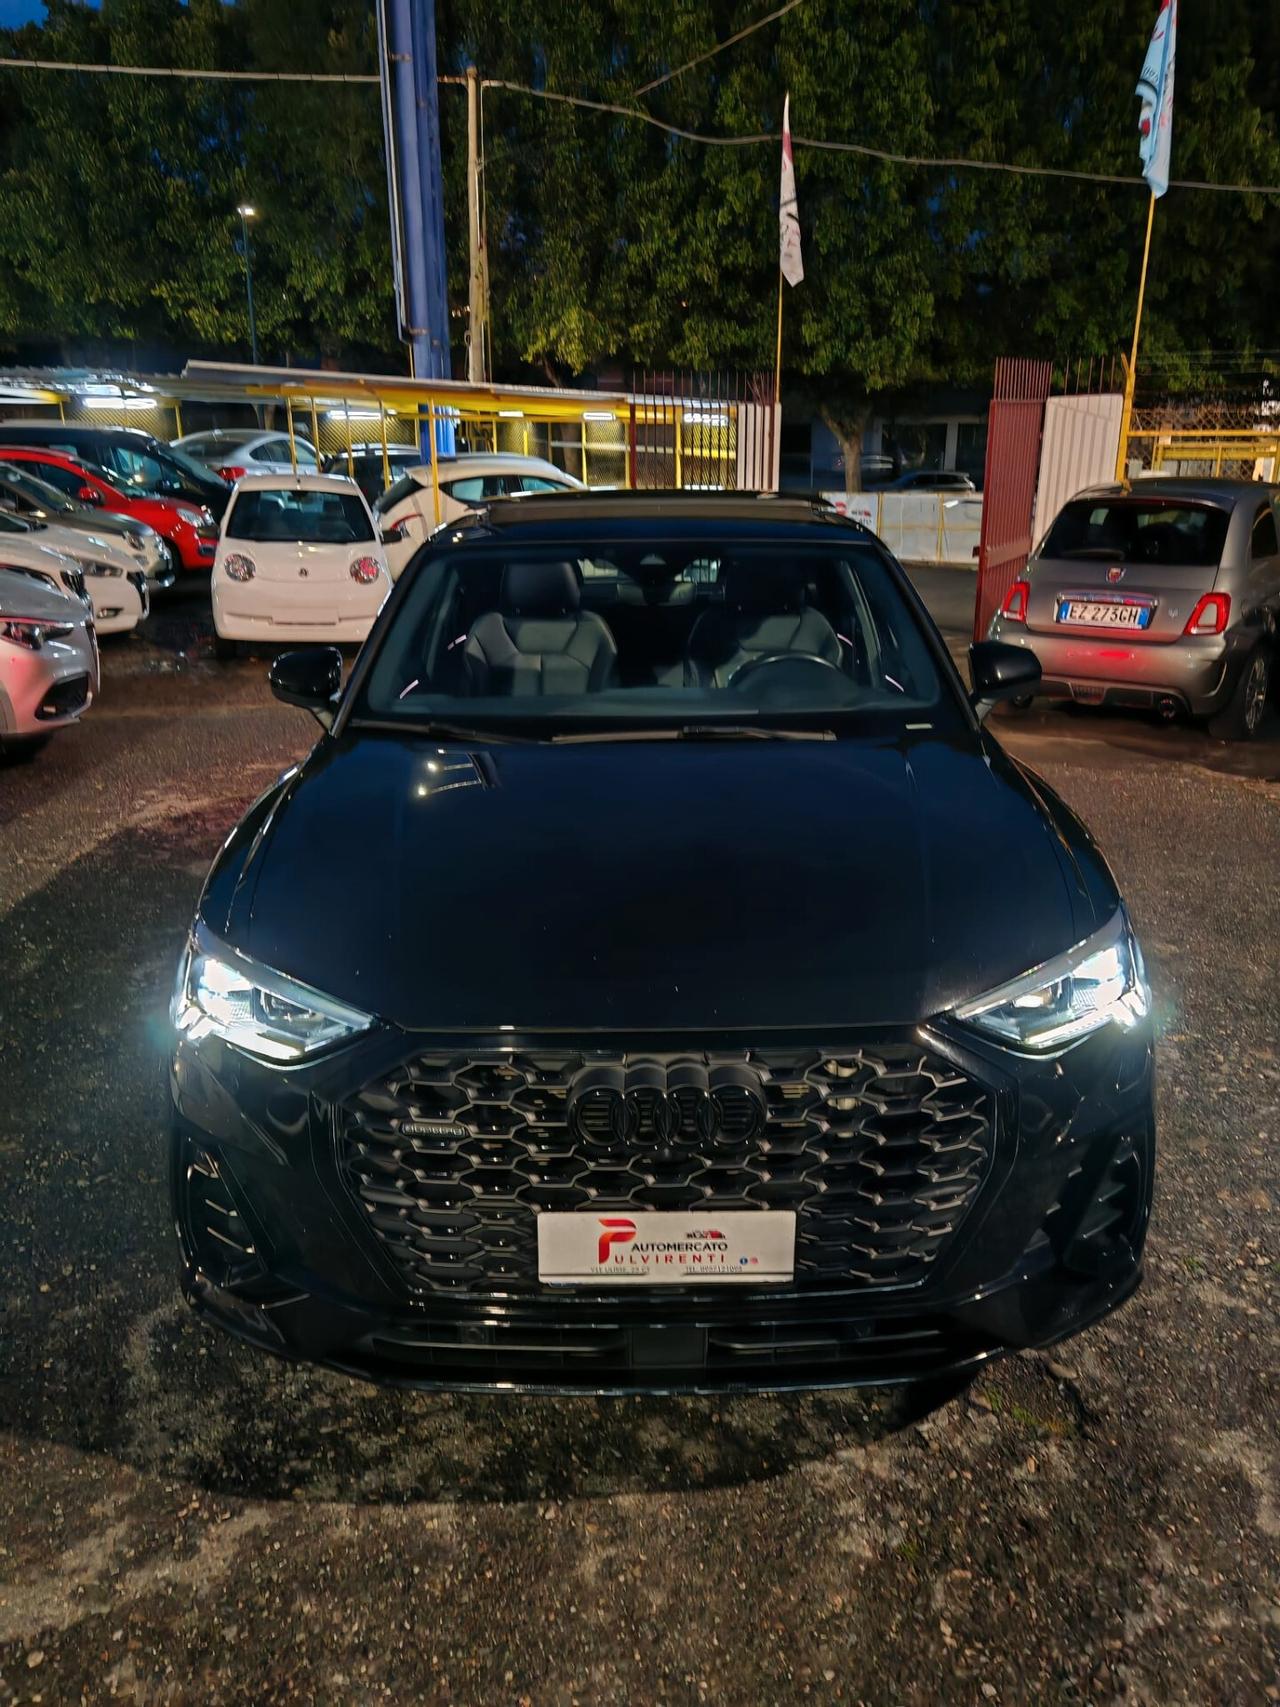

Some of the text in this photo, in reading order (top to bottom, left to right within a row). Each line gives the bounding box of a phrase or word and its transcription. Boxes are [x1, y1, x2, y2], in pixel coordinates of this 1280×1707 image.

[1069, 604, 1138, 624] EZ 273GH
[631, 1242, 728, 1252] AUTOMERCATO
